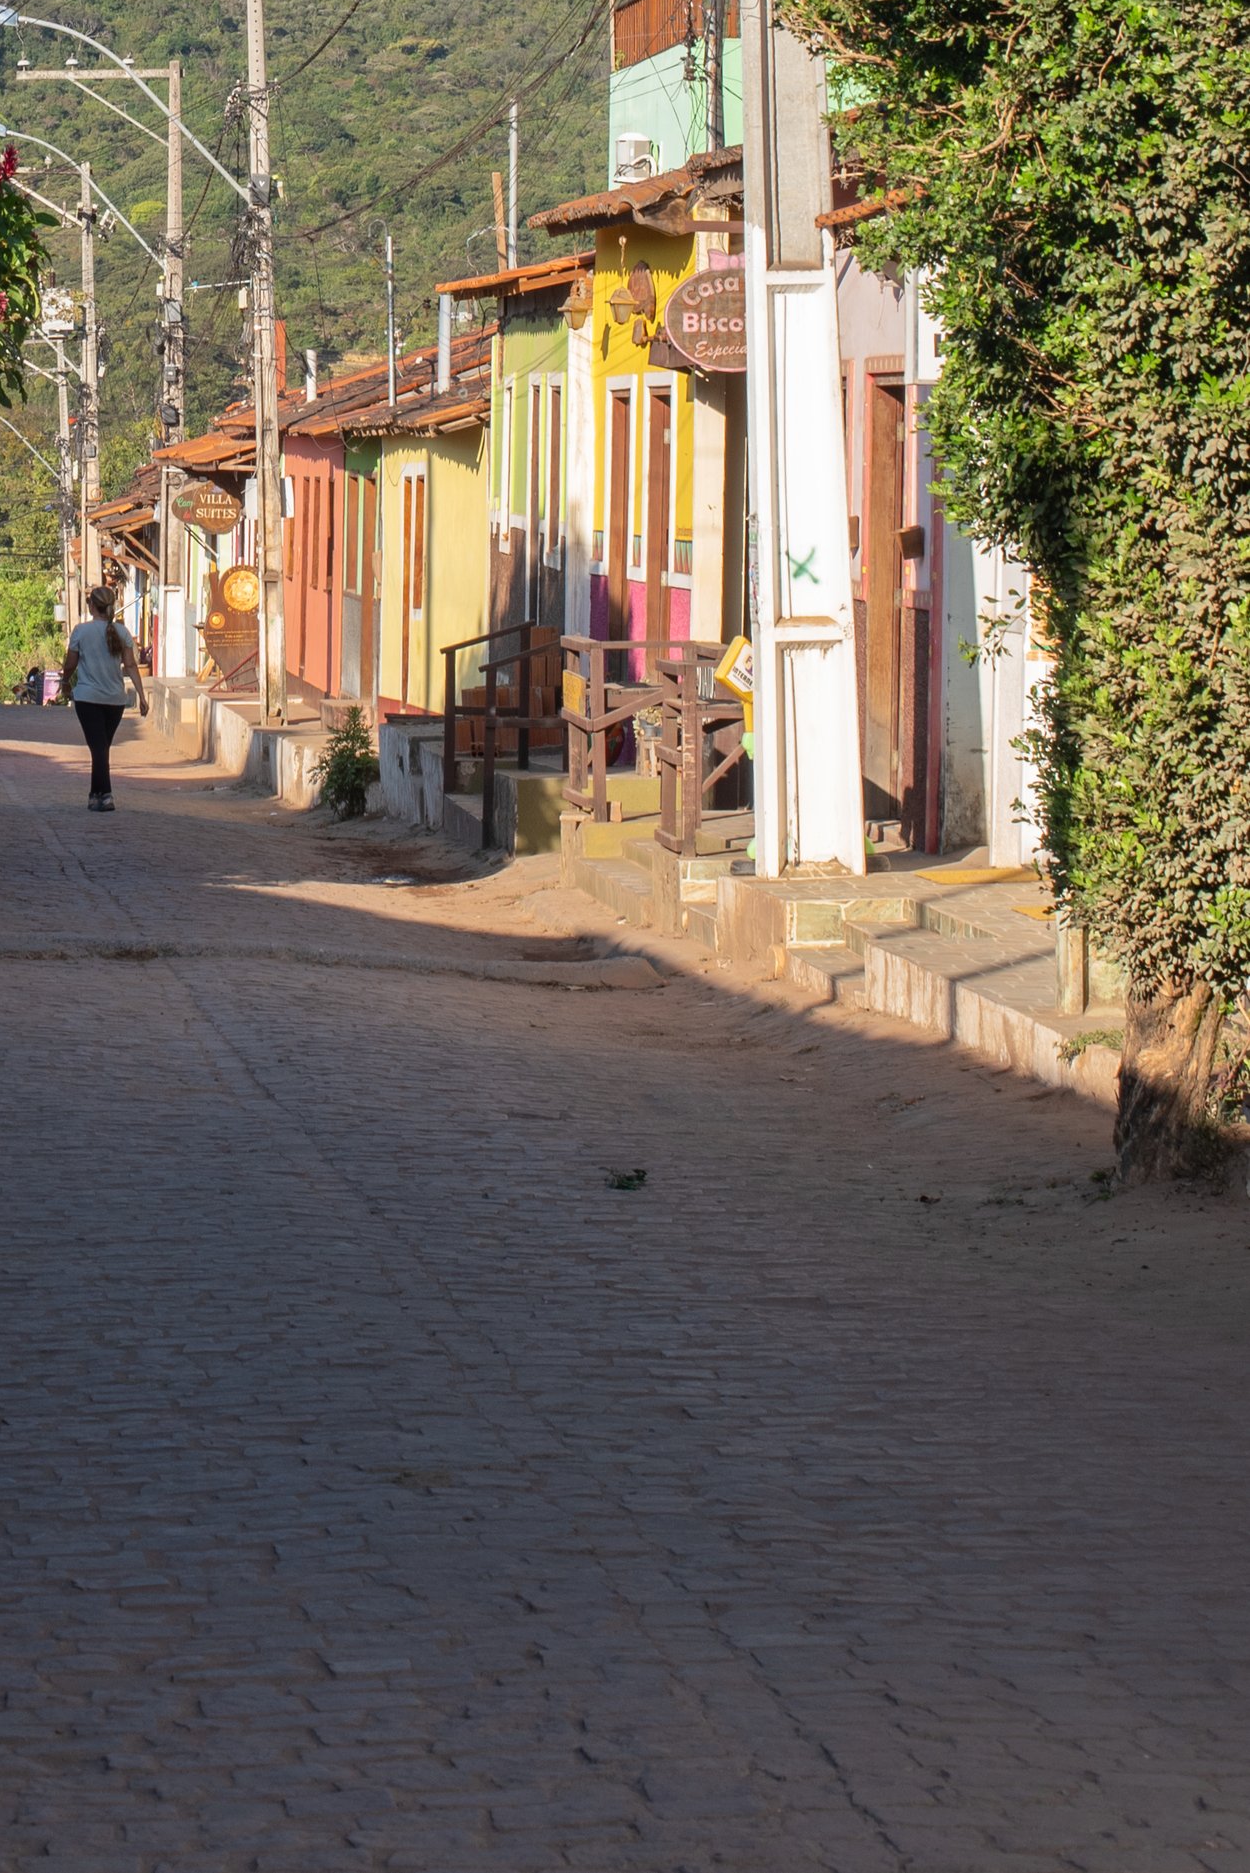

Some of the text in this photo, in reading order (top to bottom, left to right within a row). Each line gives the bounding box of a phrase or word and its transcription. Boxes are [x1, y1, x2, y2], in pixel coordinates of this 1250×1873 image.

[682, 276, 740, 306] Casa
[682, 312, 747, 333] Bisco
[200, 494, 232, 505] VILLA
[195, 508, 237, 519] SUITES
